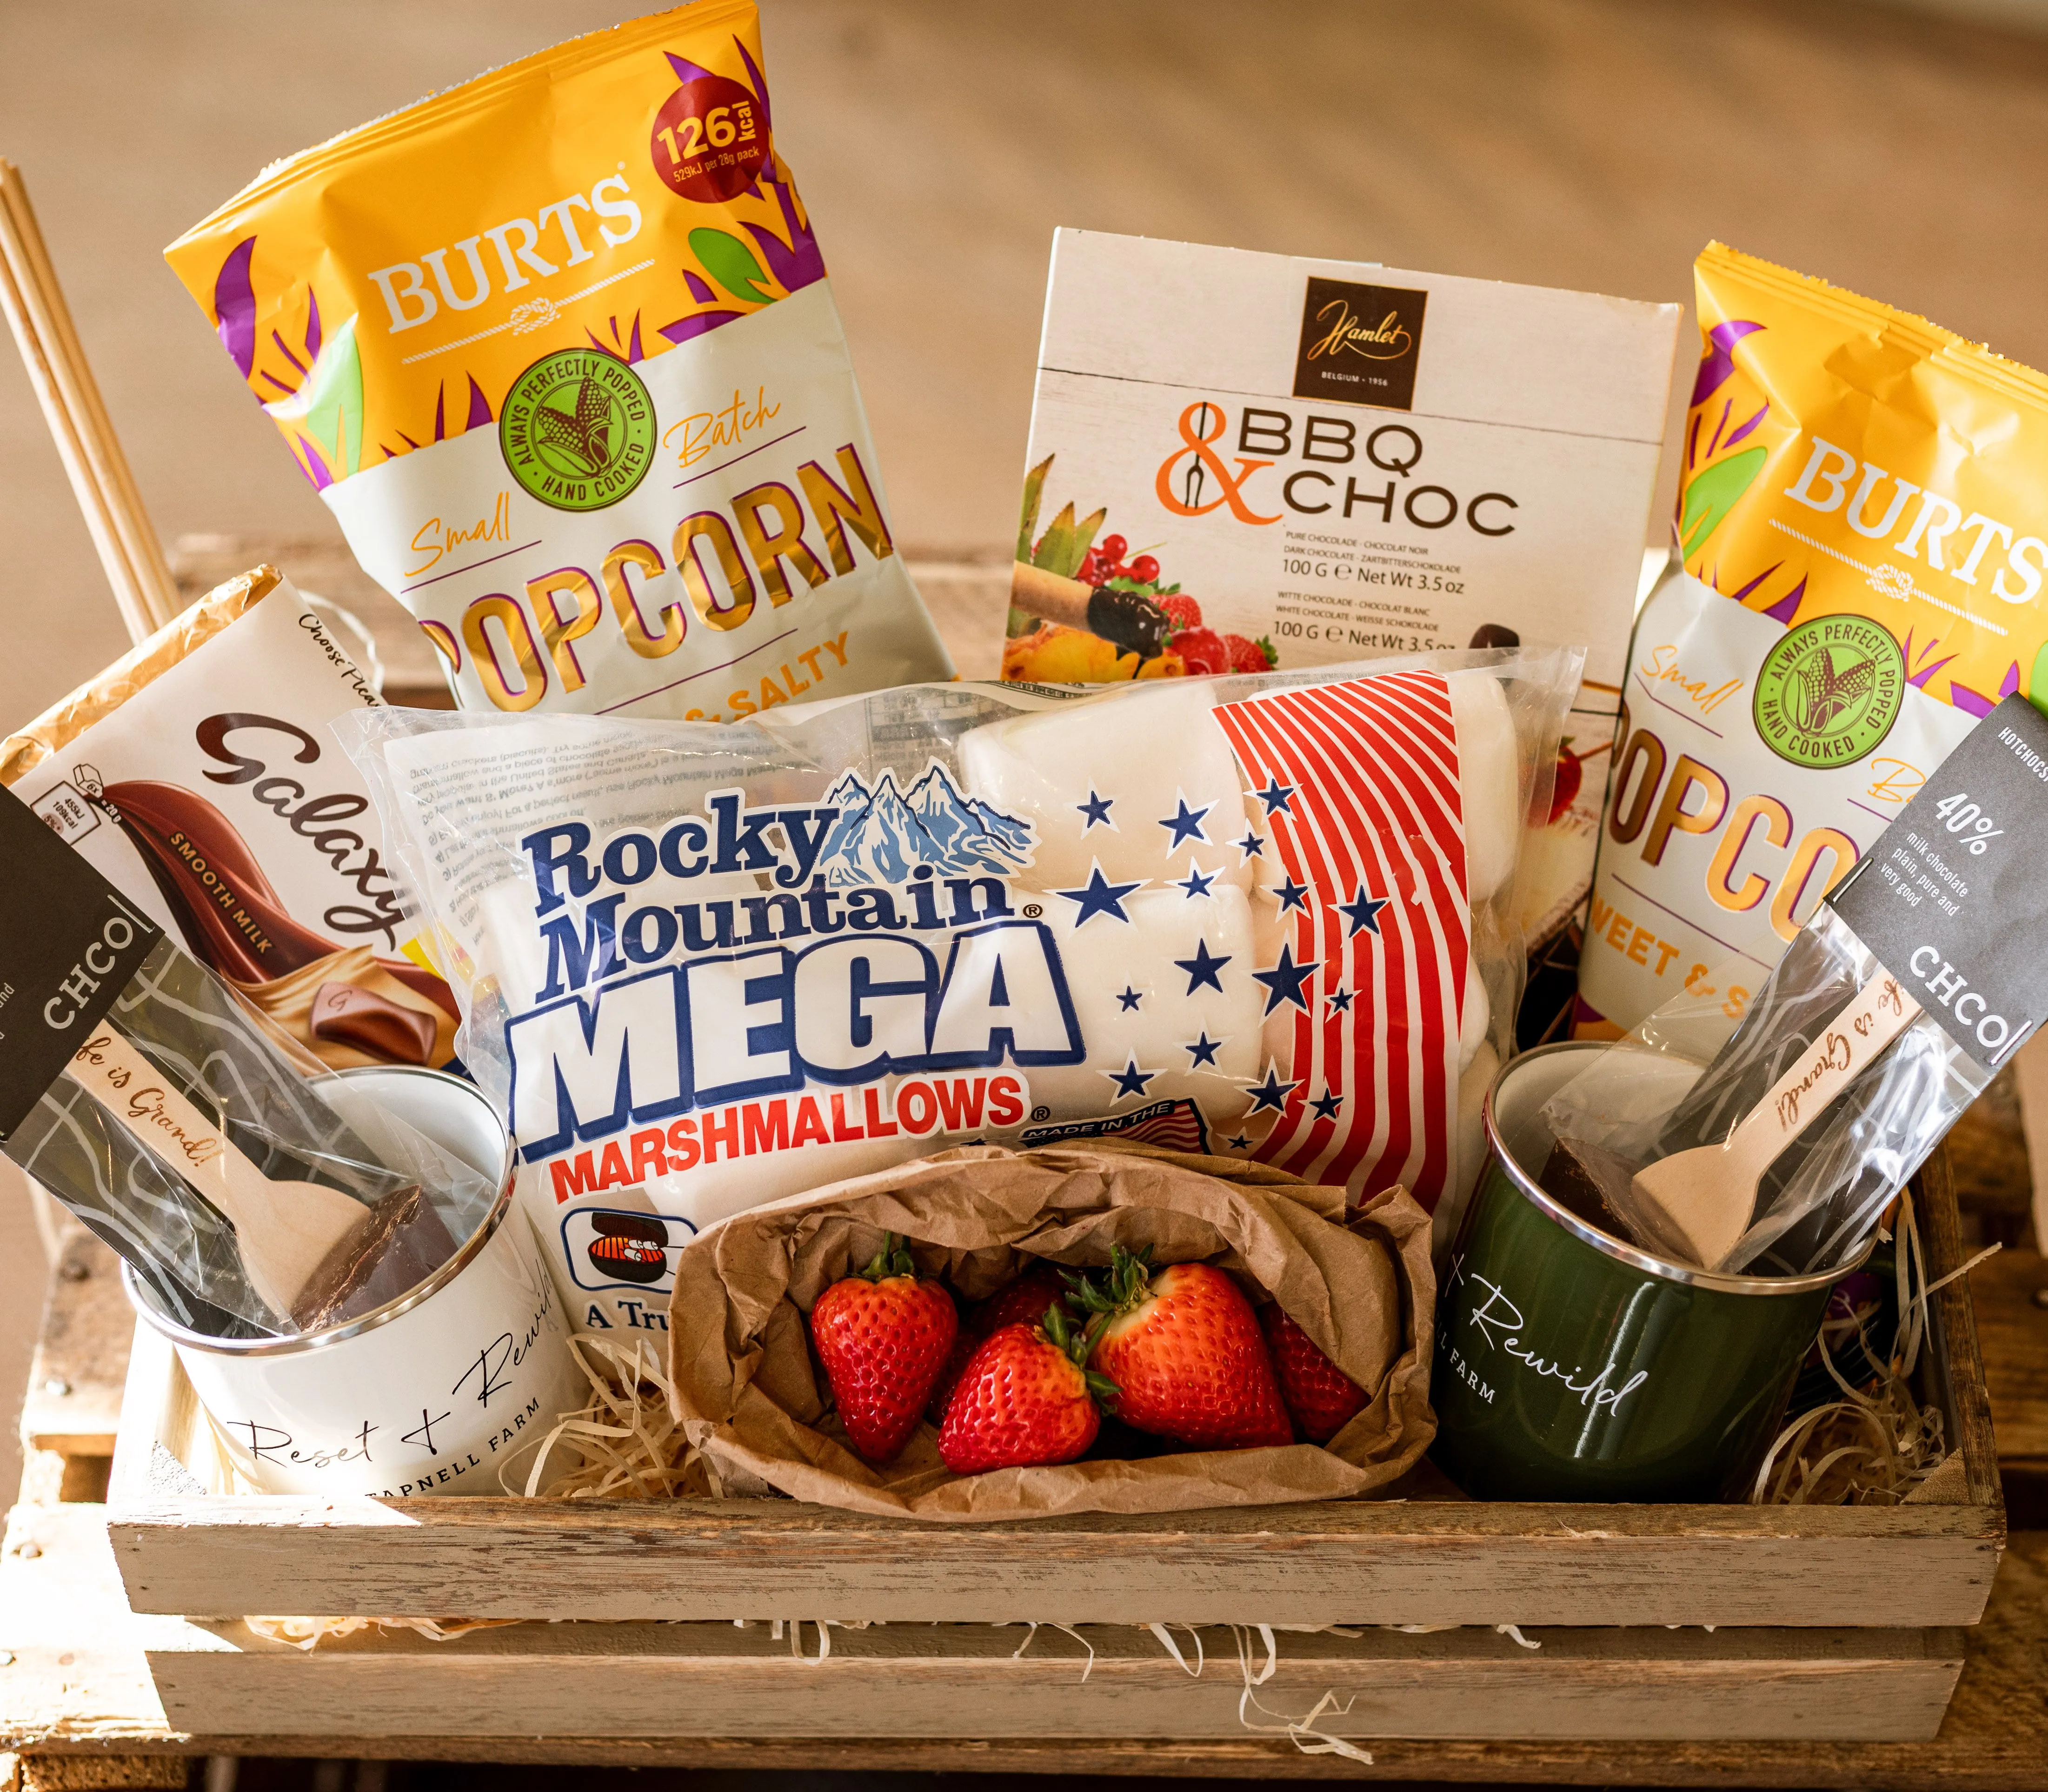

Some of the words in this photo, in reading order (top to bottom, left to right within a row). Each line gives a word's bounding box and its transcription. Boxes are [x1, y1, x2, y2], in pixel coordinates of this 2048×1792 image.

[657, 107, 736, 164] 126
[731, 100, 756, 142] kcal
[673, 162, 703, 182] 529kJ
[705, 159, 718, 172] per
[718, 153, 734, 166] 28g
[737, 146, 760, 162] pack
[368, 173, 642, 334] BURTS
[1307, 300, 1412, 361] Hamlet
[521, 359, 600, 402] PERFECTLY
[603, 366, 646, 421] POPPED
[1321, 372, 1359, 383] BELGIUM
[1368, 377, 1389, 387] 1956
[510, 405, 535, 466] ALWAYS
[663, 386, 781, 468] Batch
[1238, 407, 1422, 478] BBQ
[541, 475, 586, 501] HAND
[594, 443, 645, 497] COOKED
[404, 491, 510, 577] Small
[1283, 470, 1519, 537] CHOC
[1783, 436, 2048, 604] BURTS
[1283, 545, 1306, 555] DARK
[1307, 548, 1355, 561] CHOCOLATE
[1286, 531, 1307, 541] PURE
[1308, 534, 1357, 547] CHOCOLADE
[1364, 541, 1407, 553] CHOCOLAT
[1408, 546, 1429, 555] NOIR
[1277, 591, 1301, 601] WITTE
[1303, 594, 1353, 607] CHOCOLADE
[1359, 601, 1402, 613] CHOCOLAT
[1403, 607, 1430, 616] BLANC
[1283, 559, 1311, 575] 100
[1315, 562, 1328, 578] G
[1357, 568, 1386, 585] Net
[1390, 571, 1413, 588] Wt
[1417, 574, 1442, 592] 3.5
[1445, 582, 1465, 594] oz
[1273, 621, 1302, 638] 100
[1306, 624, 1318, 640] G
[1349, 630, 1377, 647] Net
[1382, 634, 1403, 651] Wt
[1276, 605, 1301, 615] WHITE
[299, 613, 345, 667] Choose
[341, 661, 382, 707] Plea
[728, 631, 848, 721] SALTY
[1640, 644, 1744, 715] Small
[1770, 631, 1818, 681] ALWAYS
[1825, 624, 1894, 665] PERFECTLY
[1865, 669, 1896, 730] POPPED
[1762, 699, 1788, 739] HAND
[1788, 734, 1855, 758] COOKED
[1997, 726, 2048, 782] HOTCHOCS
[53, 801, 79, 829] 109kcal
[64, 798, 85, 819] 455kJ
[86, 783, 100, 794] 6x
[105, 803, 118, 816] 20
[196, 713, 406, 952] Galaxy
[1609, 698, 1861, 945] OPCO
[1935, 793, 2004, 855] 40%
[521, 794, 840, 918] Rocky
[1881, 863, 1899, 886] very
[1896, 881, 1922, 907] good
[1892, 848, 1916, 878] plain,
[1917, 873, 1940, 898] pure
[1937, 894, 1960, 917] and
[1907, 832, 1929, 856] milk
[1926, 853, 1968, 898] chocolate
[170, 832, 236, 908] SMOOTH
[233, 909, 273, 954] MILK
[535, 865, 1015, 1004] Mountain
[44, 917, 133, 1029] CHCO
[1684, 963, 1717, 997] &
[1877, 978, 1905, 1016] fe
[1909, 946, 2008, 1048] CHCO
[505, 919, 1087, 1164] MEGA
[1854, 1012, 1874, 1037] is
[75, 1037, 112, 1065] fe
[108, 1067, 132, 1088] is
[128, 1087, 224, 1167] Grand!
[1775, 1032, 1851, 1132] Grand!
[548, 1076, 1023, 1205] MARSHMALLOWS
[1027, 1124, 1095, 1138] MADE
[1100, 1119, 1124, 1132] IN
[1130, 1103, 1171, 1124] THE
[585, 1304, 613, 1329] A
[1470, 1273, 1648, 1416] Rewild
[1449, 1348, 1496, 1404] FARM
[226, 1419, 380, 1469] Reset
[365, 1454, 480, 1496] PNELL
[488, 1397, 539, 1452] FARM
